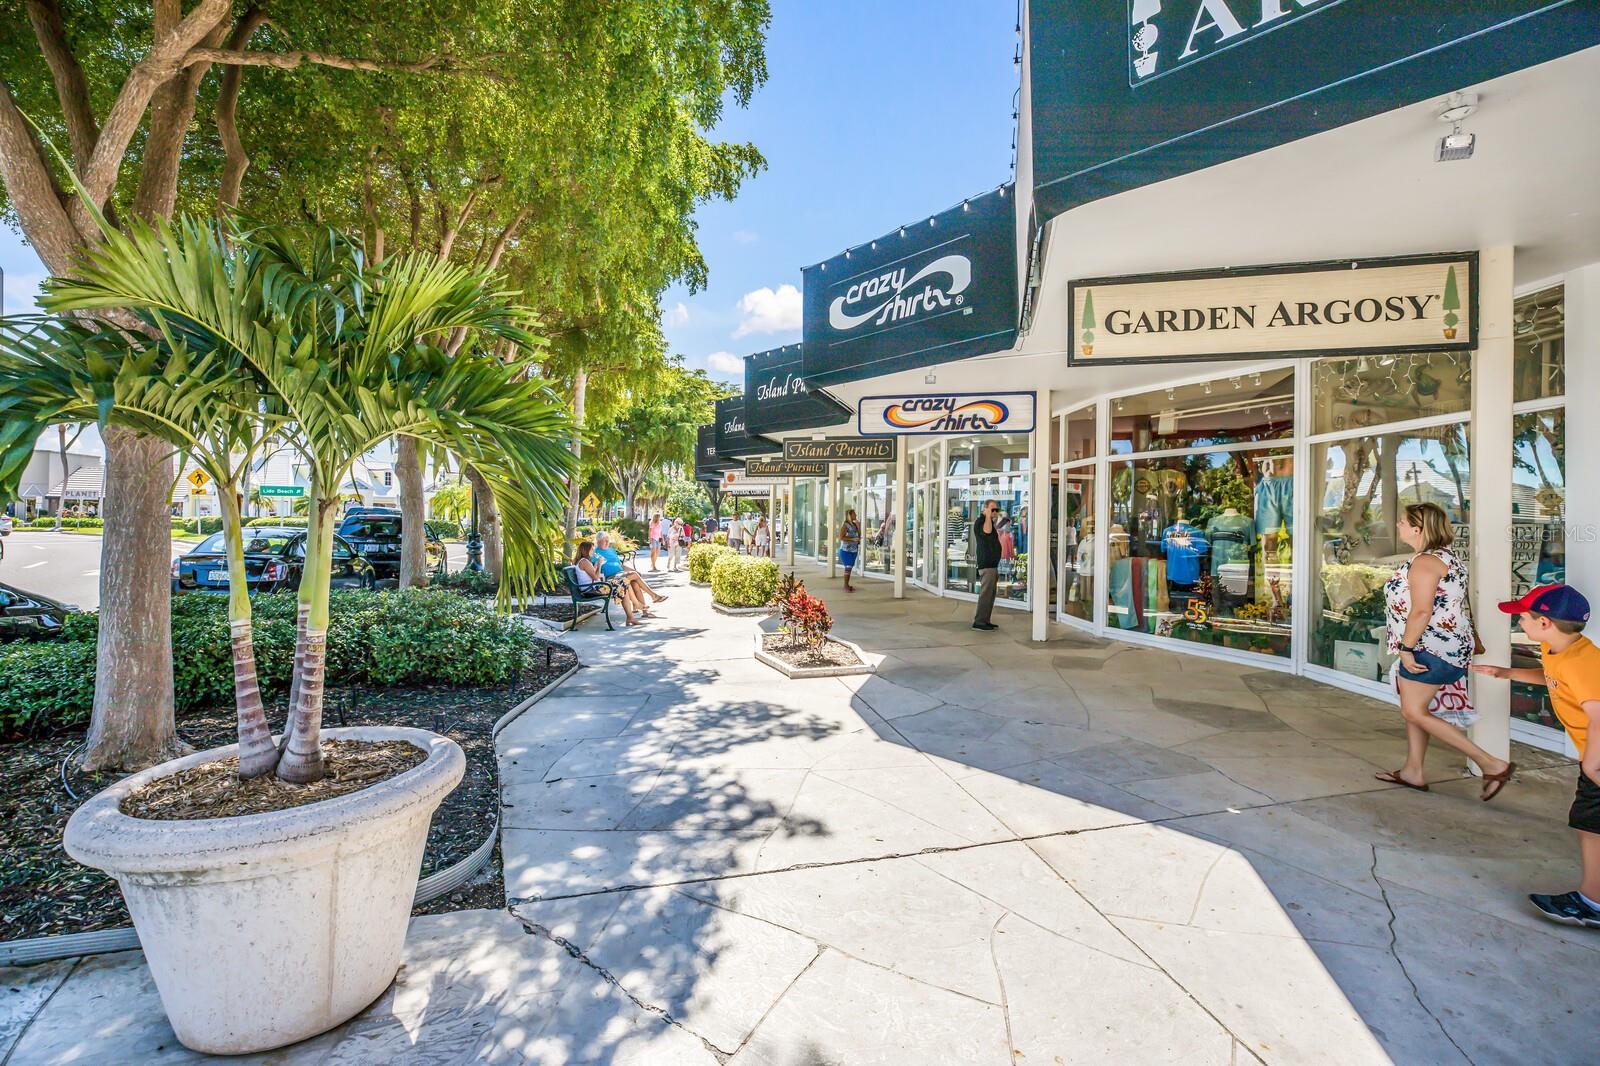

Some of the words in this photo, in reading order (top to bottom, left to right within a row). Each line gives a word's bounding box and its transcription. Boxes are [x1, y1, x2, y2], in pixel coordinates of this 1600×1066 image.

[846, 267, 906, 304] crazy
[1104, 304, 1257, 335] GARDEN
[1266, 294, 1435, 328] ARGOSY
[757, 373, 793, 401] Island
[902, 398, 957, 412] crazy
[789, 443, 835, 457] Island
[835, 442, 889, 457] Pursuit
[750, 462, 782, 472] Island
[783, 462, 824, 472] Pursuit
